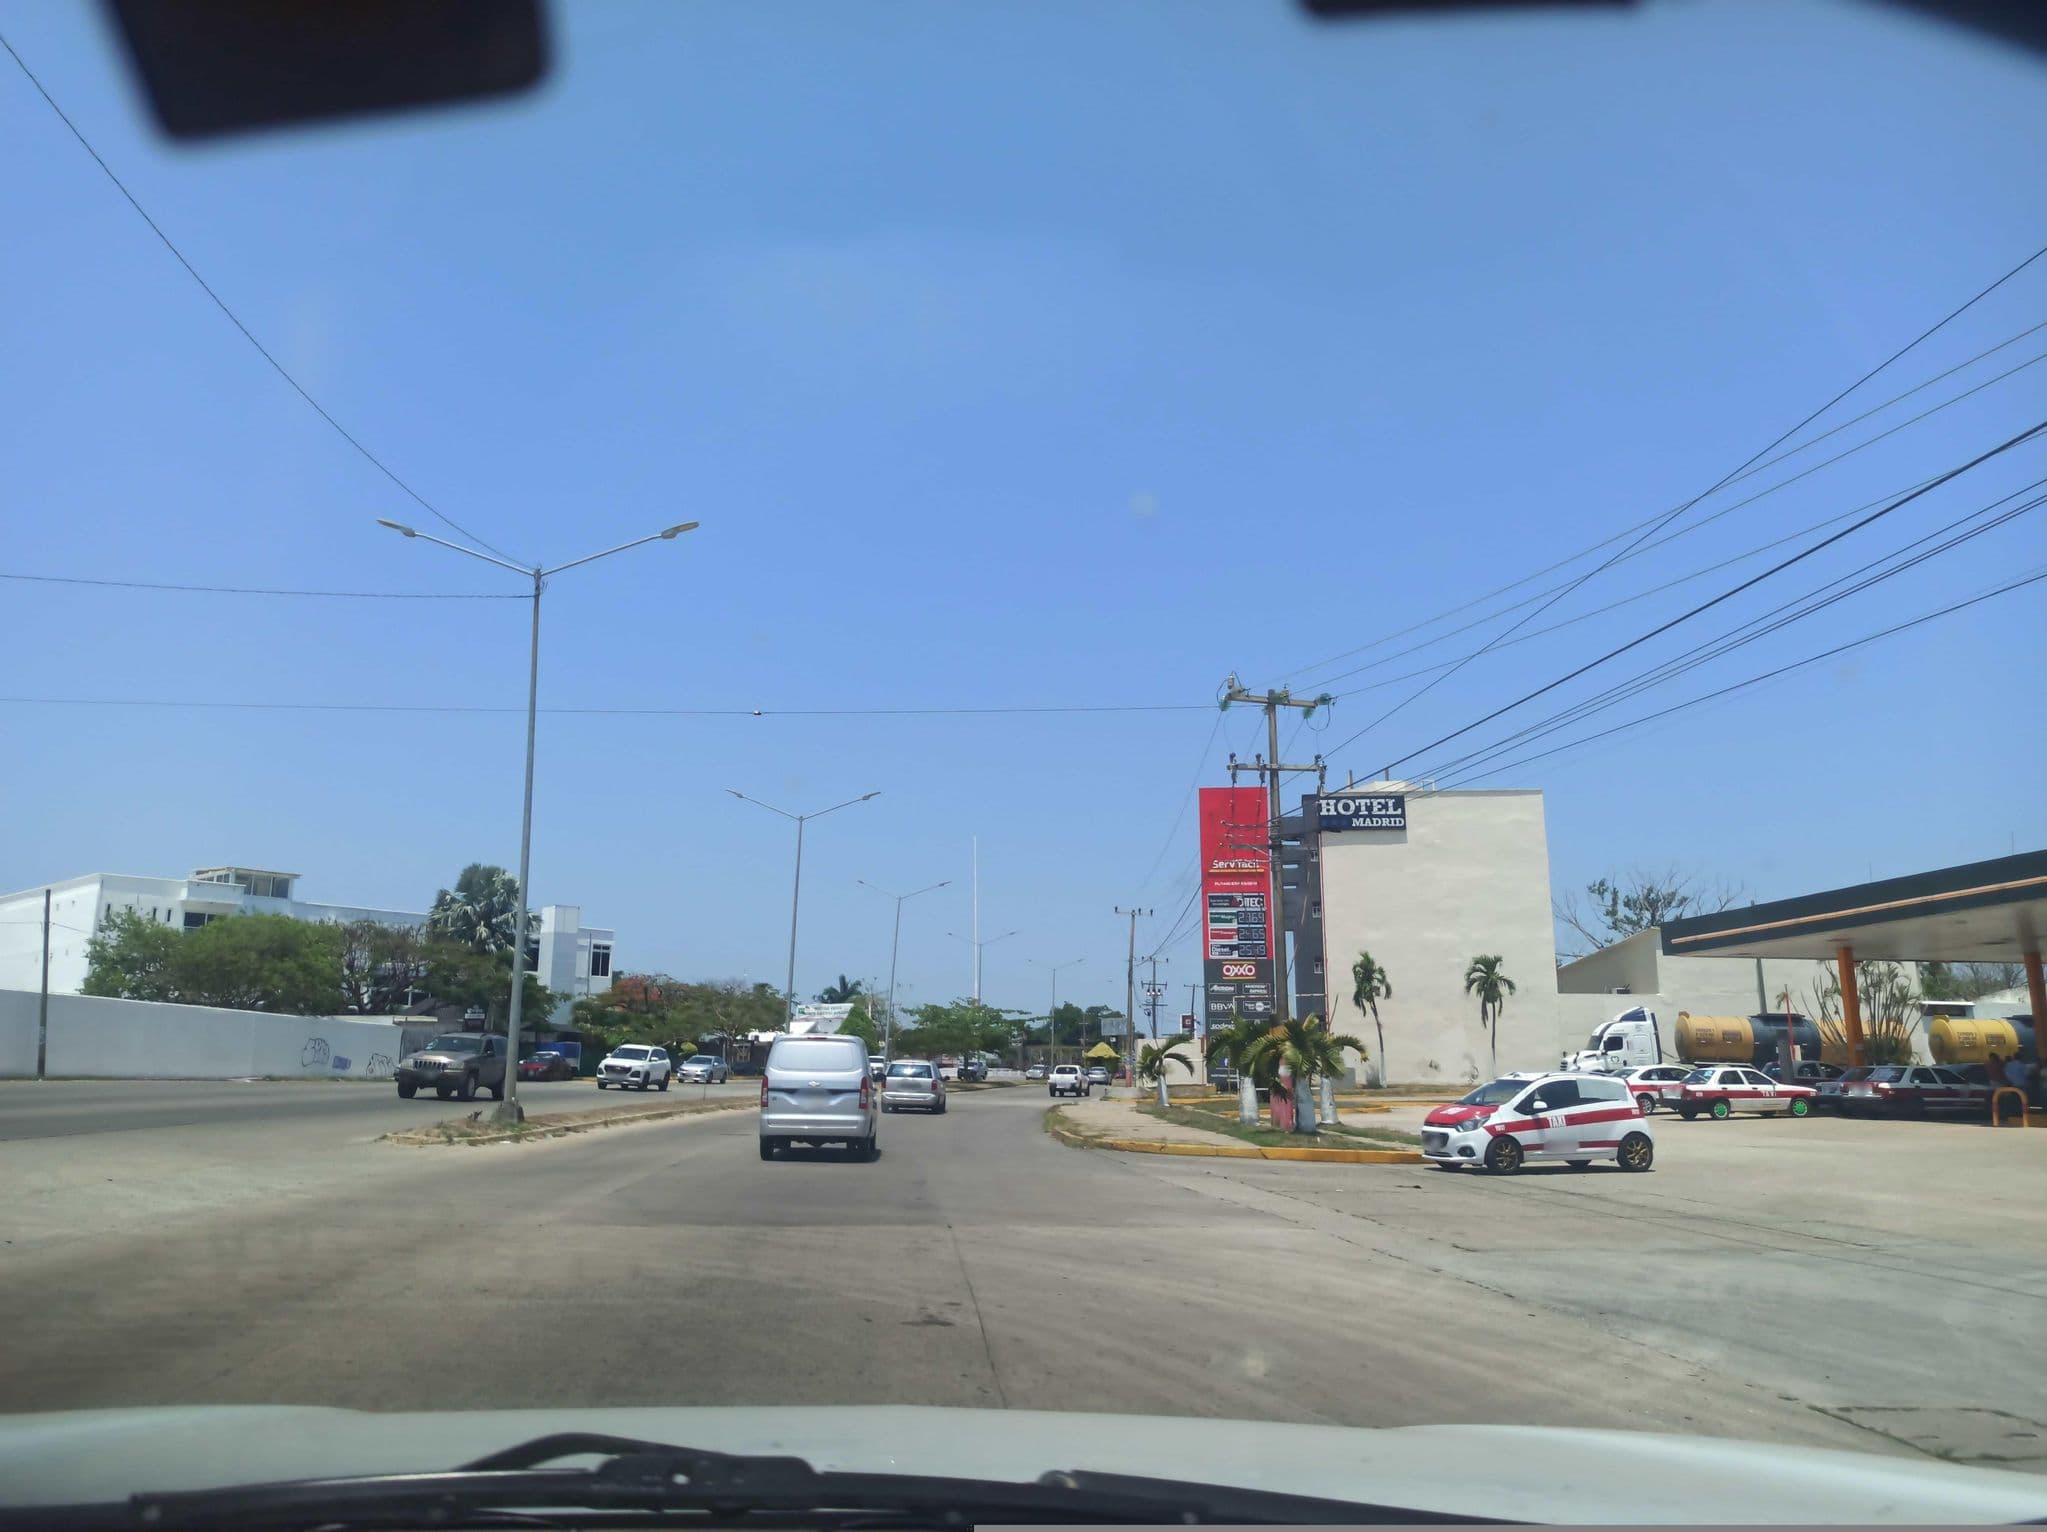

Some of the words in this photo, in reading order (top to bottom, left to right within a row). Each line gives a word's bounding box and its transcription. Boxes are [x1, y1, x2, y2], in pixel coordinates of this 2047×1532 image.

[1320, 798, 1402, 816] HOTEL
[1352, 817, 1405, 827] MADRID
[1223, 963, 1256, 977] OXXO
[1210, 1002, 1236, 1011] BBVA
[1547, 1114, 1566, 1128] TAXI
